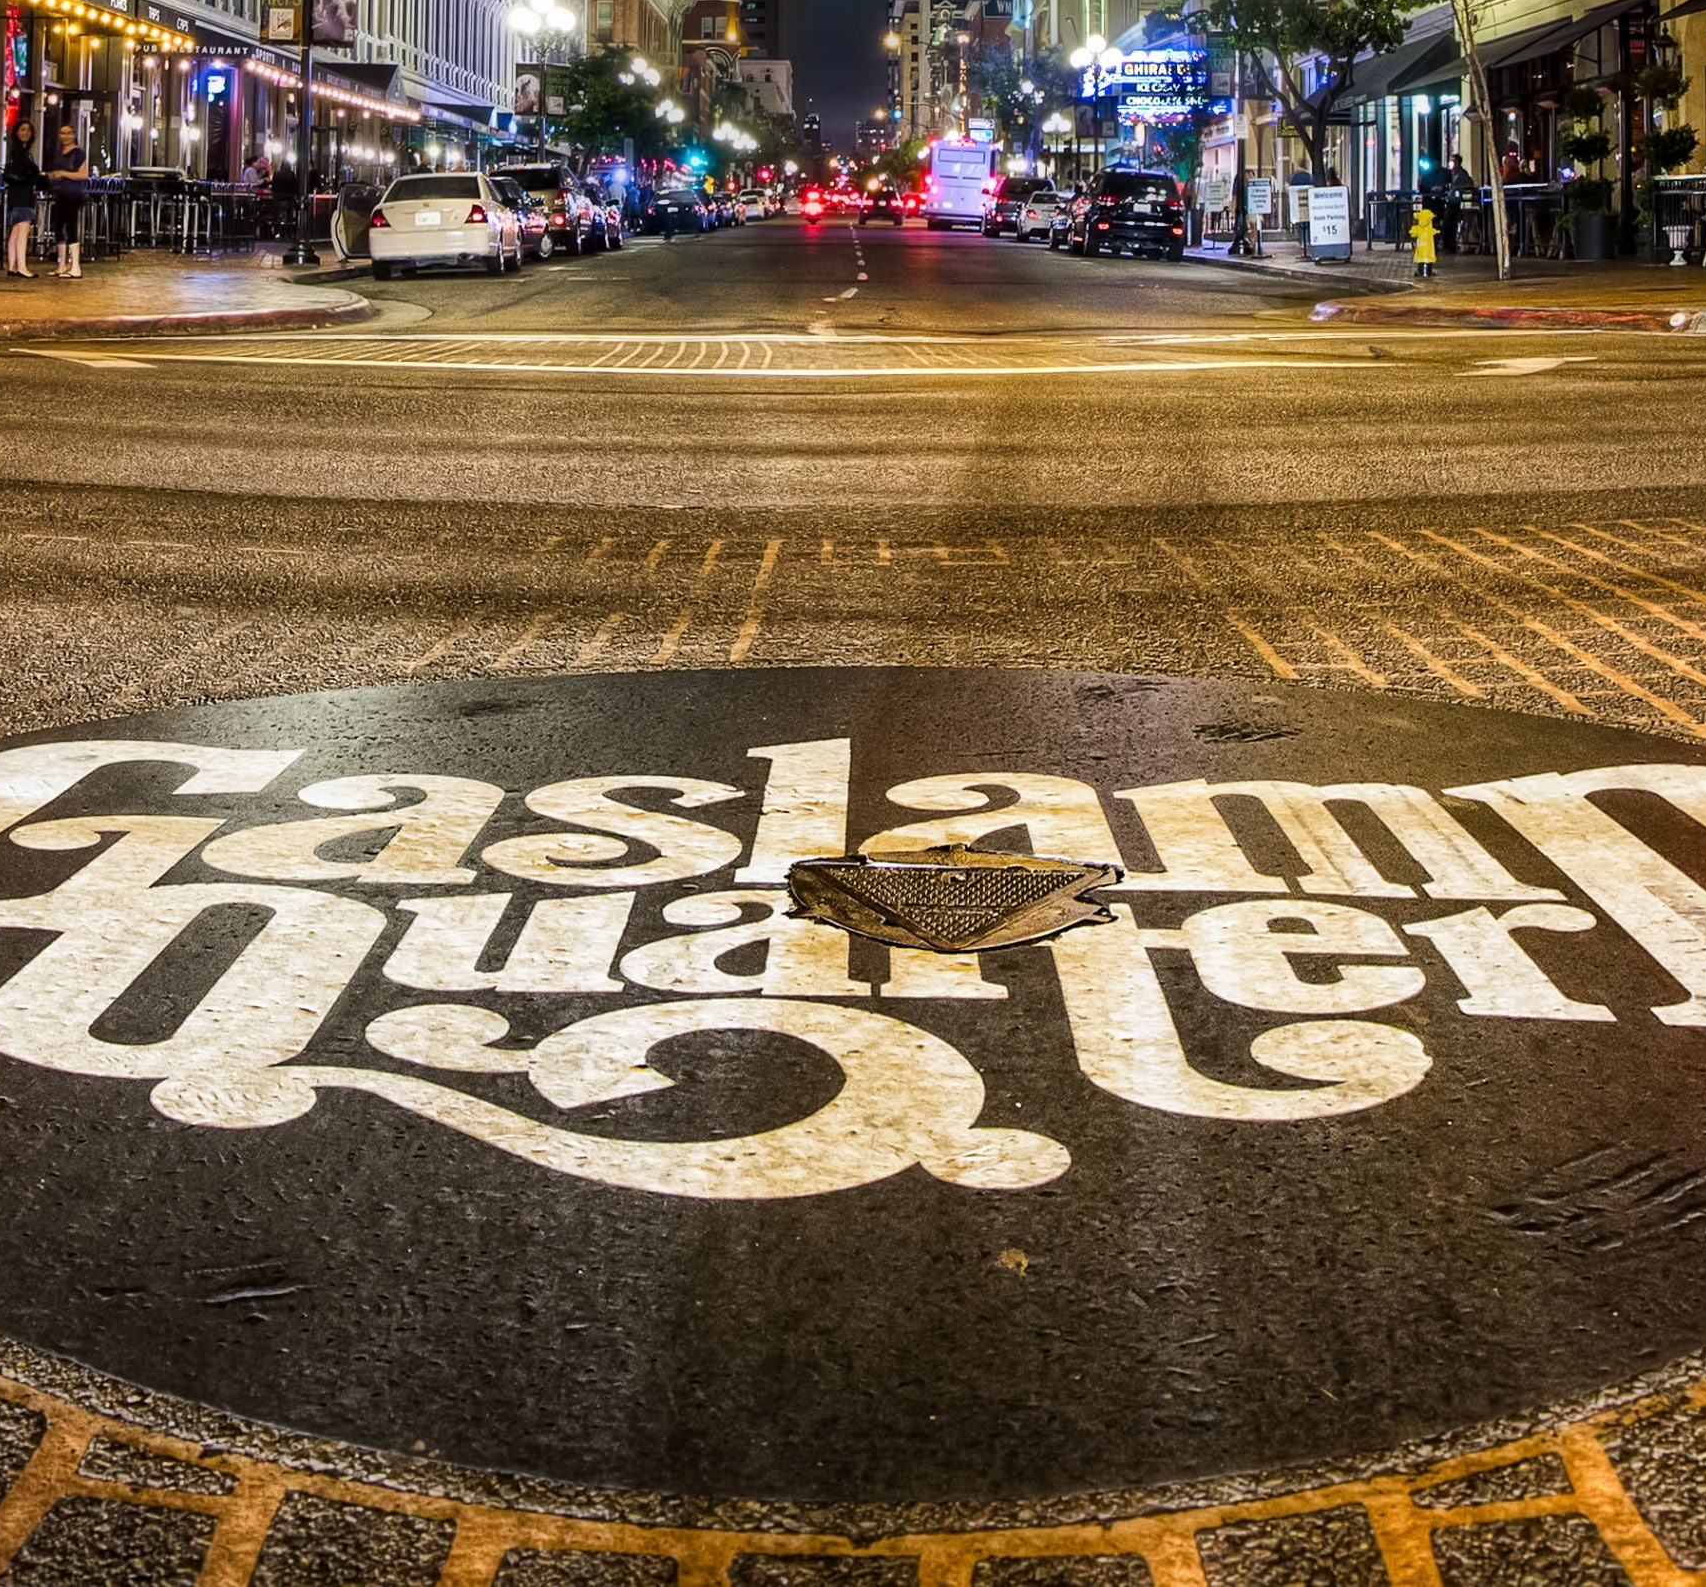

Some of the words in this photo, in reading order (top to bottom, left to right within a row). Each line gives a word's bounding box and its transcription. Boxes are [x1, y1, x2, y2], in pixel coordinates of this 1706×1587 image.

[148, 6, 160, 22] TAPS
[176, 17, 189, 32] CAPS
[134, 44, 158, 53] PUB
